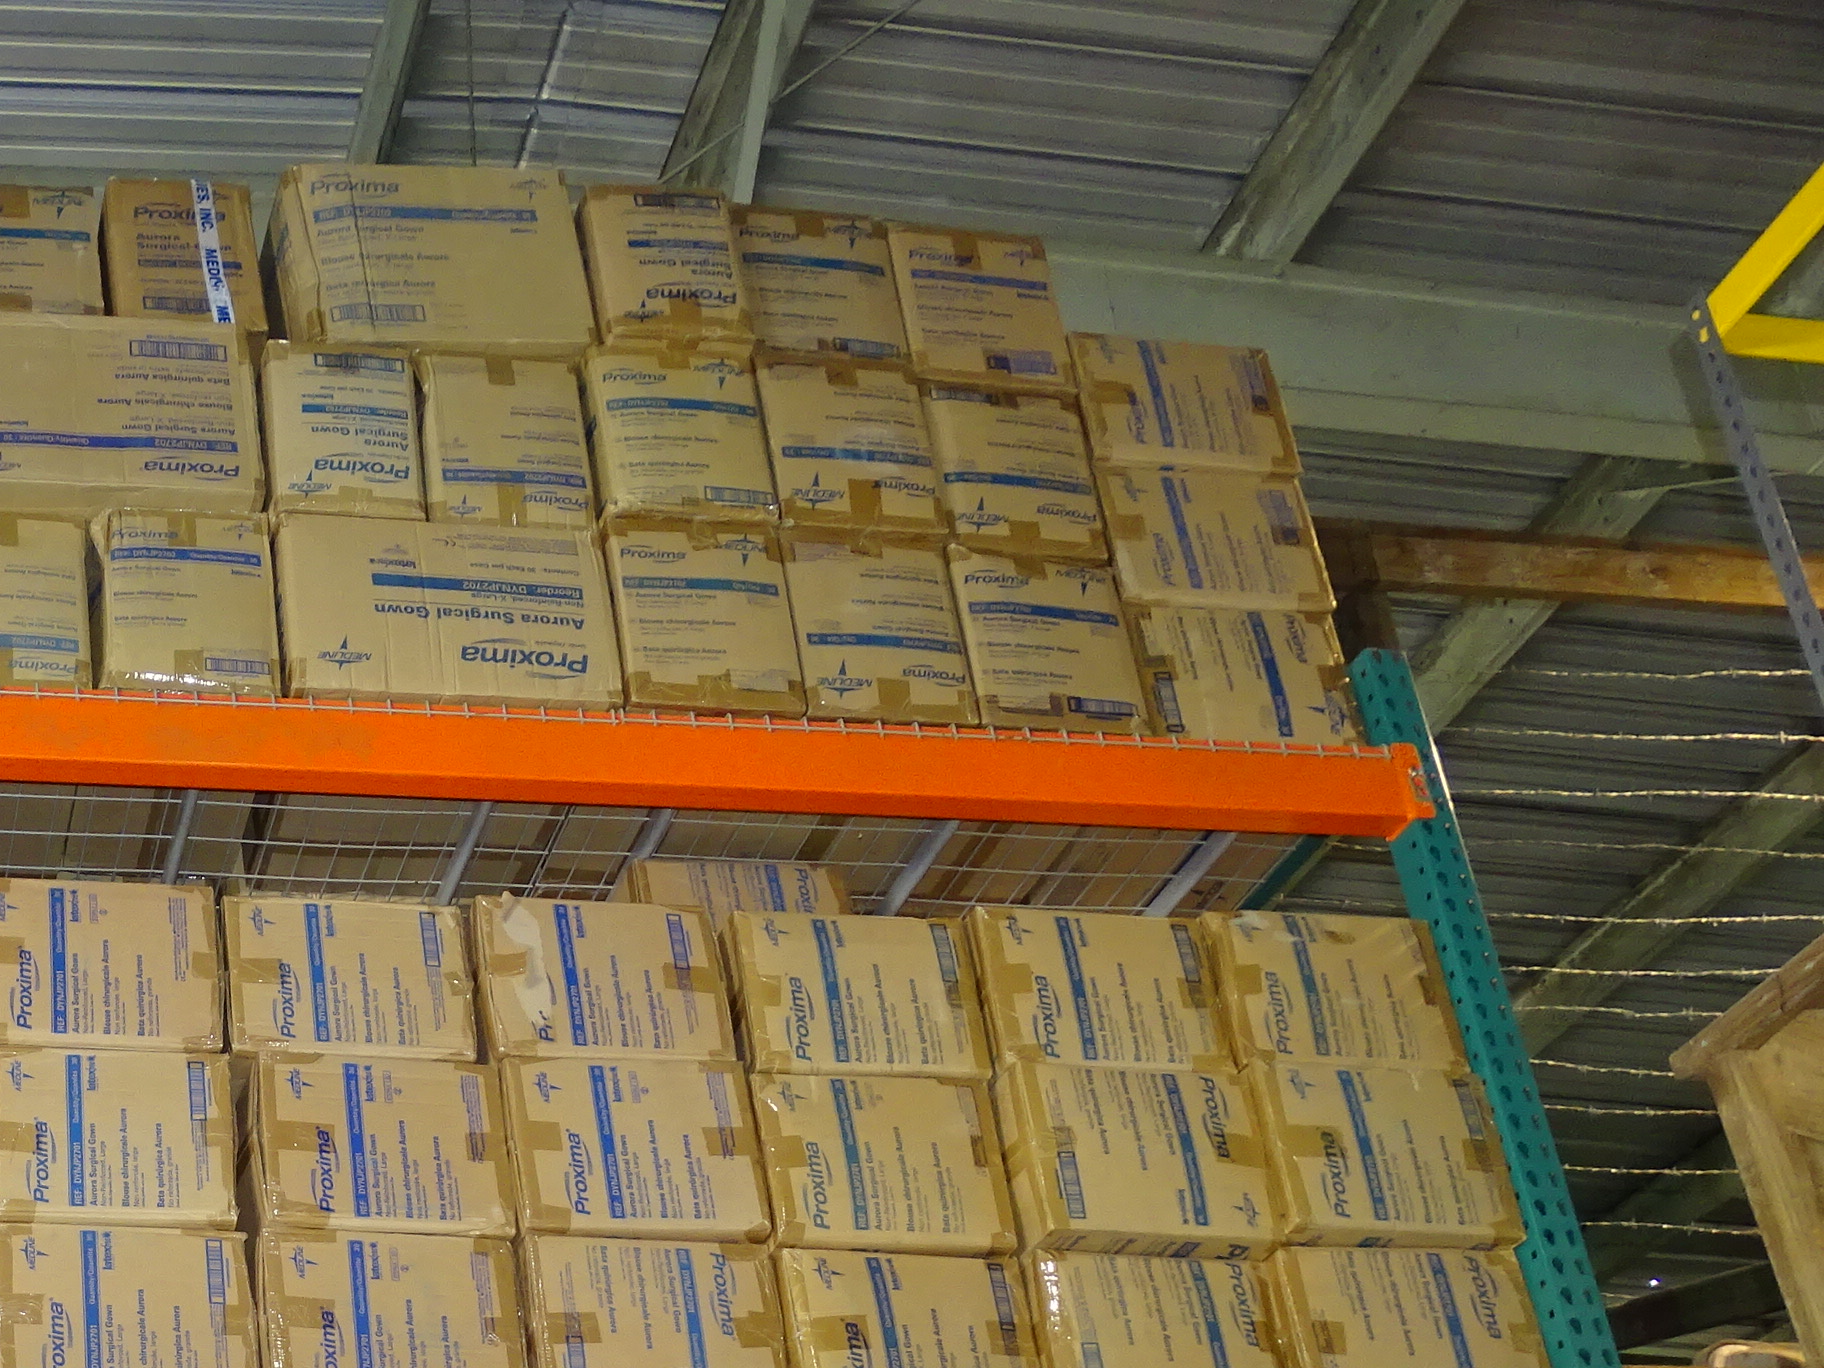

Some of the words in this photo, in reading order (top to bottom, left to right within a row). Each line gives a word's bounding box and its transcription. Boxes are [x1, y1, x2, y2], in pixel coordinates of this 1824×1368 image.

[310, 180, 400, 195] Proxima
[646, 289, 737, 304] Proxima
[602, 371, 667, 383] Proxima
[311, 425, 350, 436] Gown
[354, 427, 408, 439] Surgical
[364, 438, 409, 451] Aurora
[145, 460, 240, 478] Proxima
[314, 458, 410, 480] Proxima
[620, 548, 687, 561] Proxima
[462, 580, 527, 594] DYNJP2702
[965, 574, 1029, 587] Proxima
[374, 603, 431, 619] Gown
[437, 605, 515, 625] Surgical
[521, 614, 585, 630] Aurora
[317, 650, 372, 662] MEDLINE
[461, 645, 588, 674] Proxima
[817, 677, 873, 688] MEDLINE
[902, 669, 966, 684] Proxima
[16, 949, 33, 1030] Proxima
[279, 963, 296, 1038] Proxima
[789, 977, 812, 1062] Proxima
[1035, 975, 1060, 1059] Proxima
[1265, 972, 1293, 1054] Proxima
[14, 1060, 23, 1092] MEDLINE
[1199, 1076, 1231, 1159] Proxima
[33, 1120, 50, 1204] Proxima
[316, 1130, 335, 1213] Proxima
[570, 1133, 591, 1216] Proxima
[806, 1141, 830, 1229] Proxima
[1320, 1132, 1351, 1218] Proxima
[295, 1246, 305, 1279] MEDLINE
[710, 1253, 736, 1336] Proxima
[1225, 1261, 1260, 1347] Proxima
[1464, 1255, 1502, 1340] Proxima
